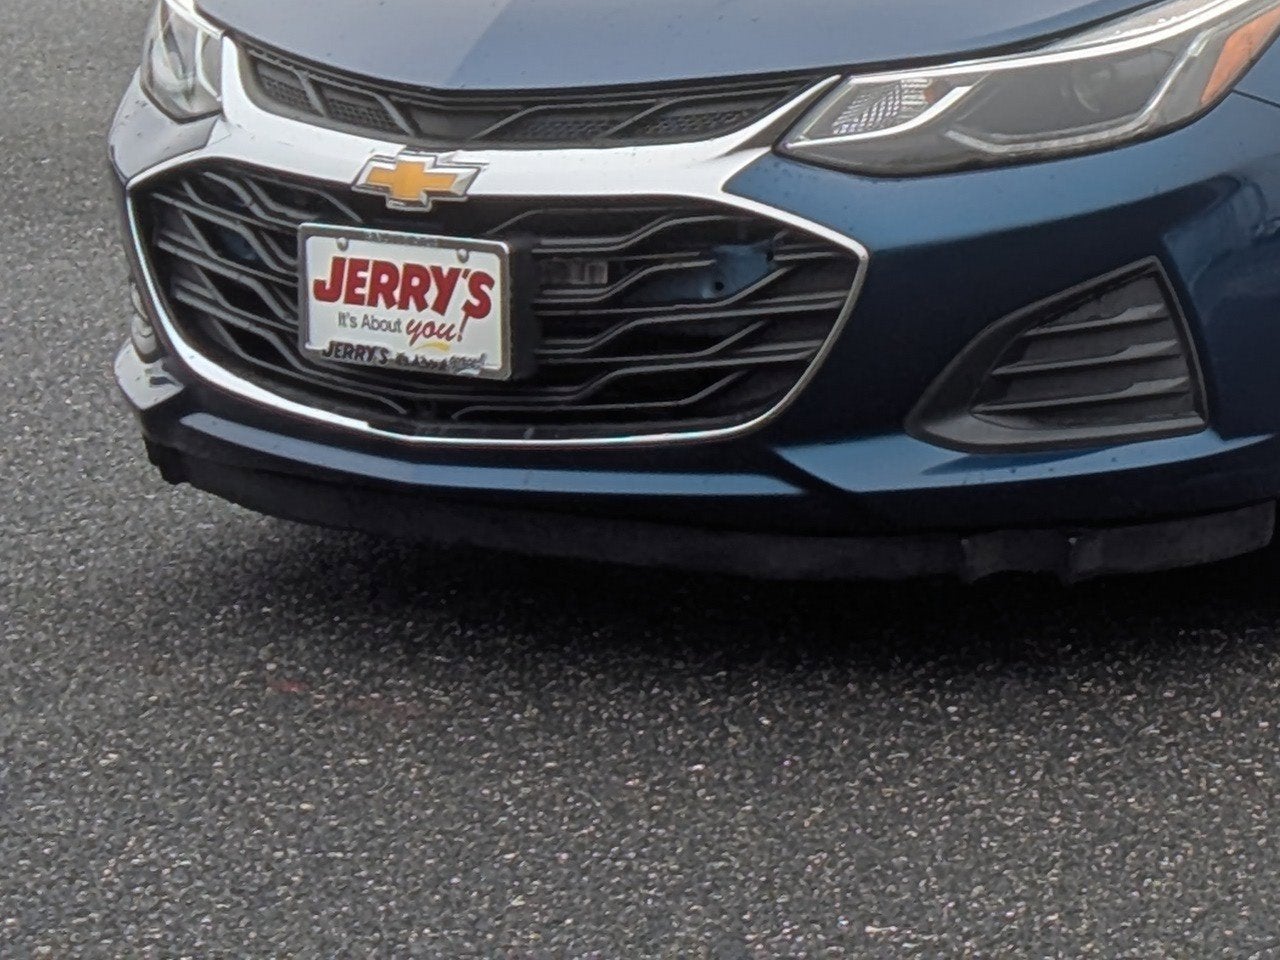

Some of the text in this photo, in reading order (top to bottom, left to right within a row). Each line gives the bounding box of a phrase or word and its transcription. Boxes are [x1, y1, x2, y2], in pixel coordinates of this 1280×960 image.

[312, 256, 495, 319] JERRY'S
[338, 311, 469, 347] It's About you!
[322, 340, 391, 365] JERRY'S
